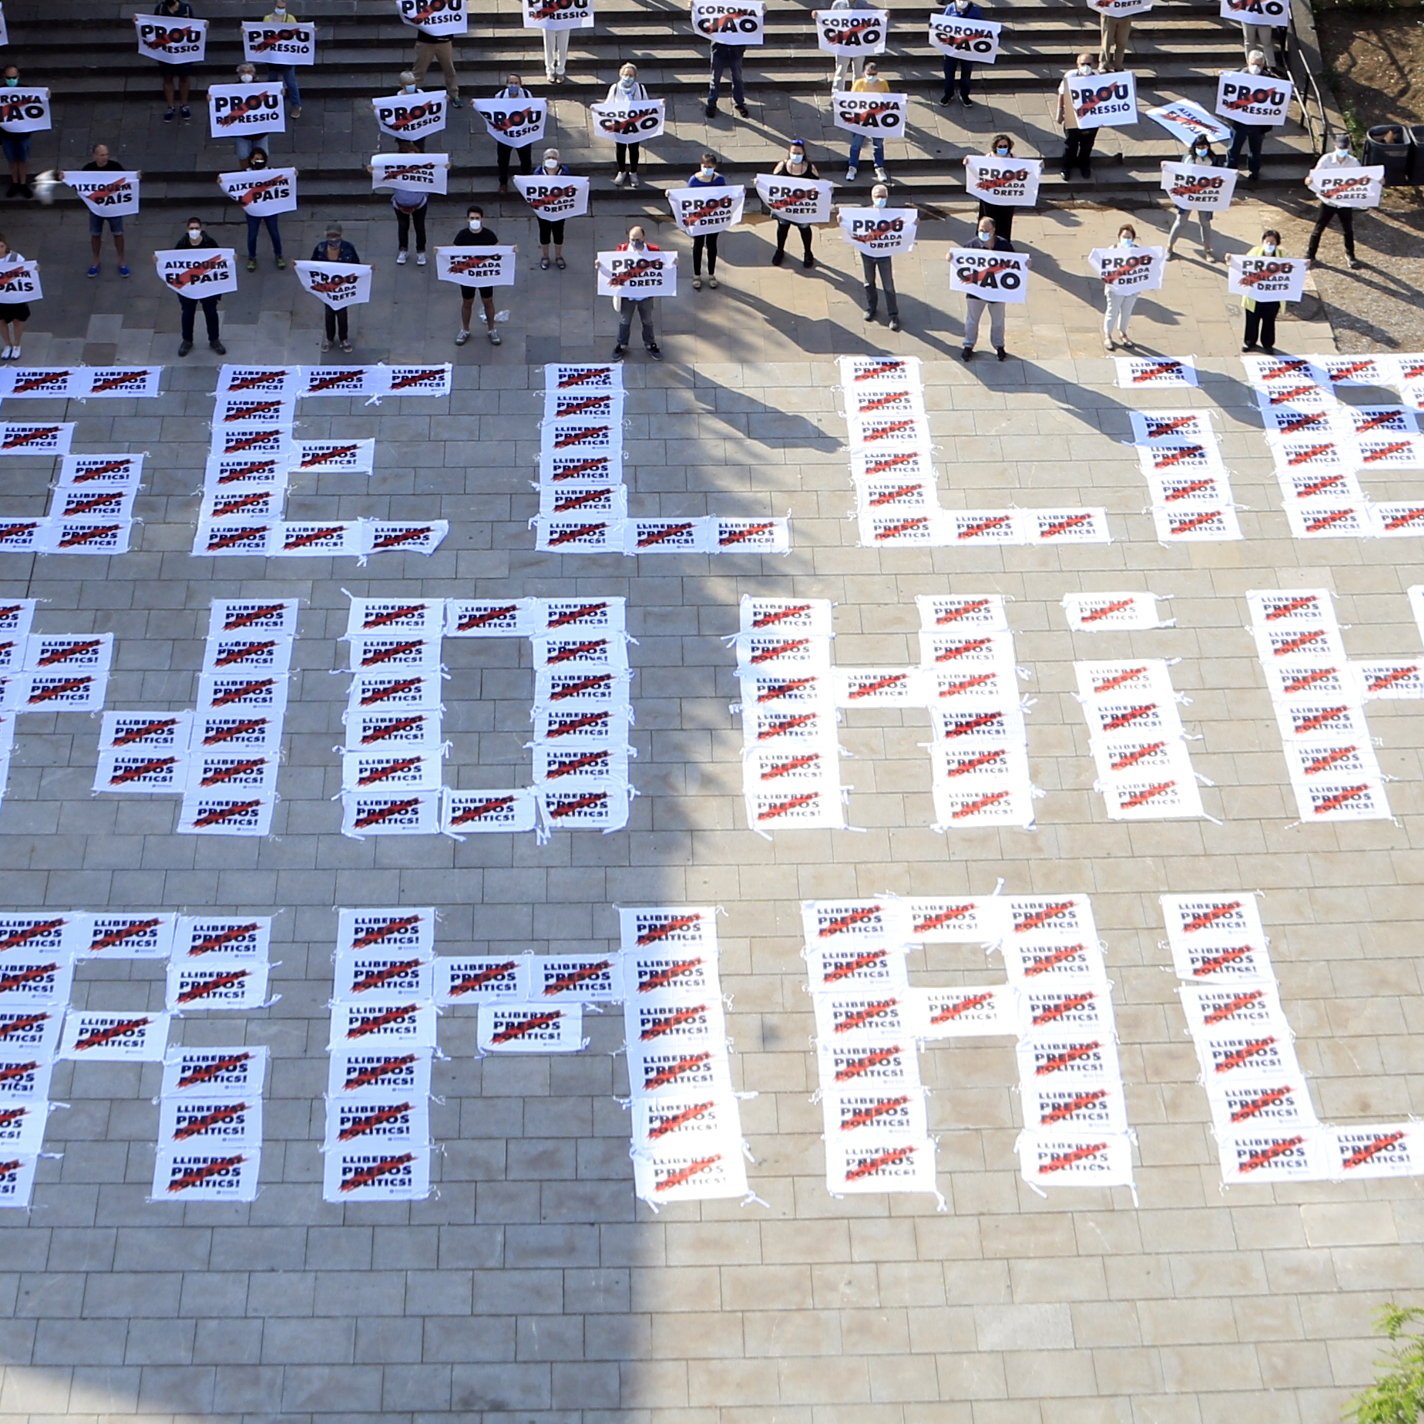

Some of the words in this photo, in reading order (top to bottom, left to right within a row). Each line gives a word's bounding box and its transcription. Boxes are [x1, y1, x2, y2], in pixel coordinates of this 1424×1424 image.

[1114, 0, 1142, 8] DRETS
[698, 6, 758, 17] CORONA
[698, 19, 758, 34] CIAO
[822, 18, 881, 27] CORONA
[142, 25, 200, 44] PROU
[248, 29, 310, 43] PROU
[824, 29, 880, 46] CIAO
[935, 24, 993, 39] CORONA
[936, 33, 992, 53] CIAO
[1223, 83, 1285, 105] PROU
[215, 95, 278, 112] PROU
[839, 100, 900, 110] CORONA
[380, 102, 441, 121] PROU
[598, 108, 658, 119] CORONA
[839, 111, 899, 127] CIAO
[600, 117, 658, 135] CIAO
[402, 175, 433, 184] DRETS
[979, 168, 1027, 181] PROU
[1175, 173, 1223, 189] PROU
[1322, 176, 1370, 187] PROU
[254, 189, 290, 203] PAÍS
[527, 186, 576, 197] PROU
[769, 186, 818, 201] PROU
[1336, 192, 1366, 200] DRETS
[682, 197, 732, 210] PROU
[786, 206, 816, 214] DRETS
[700, 216, 730, 226] DRETS
[853, 219, 904, 232] PROU
[612, 259, 663, 270] PROU
[956, 257, 1021, 270] CORONA
[1102, 255, 1151, 269] PROU
[1242, 260, 1292, 274] PROU
[191, 271, 229, 285] PAÍS
[468, 269, 501, 277] DRETS
[957, 267, 1021, 290] CIAO
[630, 279, 663, 287] DRETS
[1119, 276, 1149, 285] DRETS
[1258, 283, 1289, 291] DRETS
[1293, 714, 1350, 722] PRESOS
[818, 916, 882, 925] PRESOS
